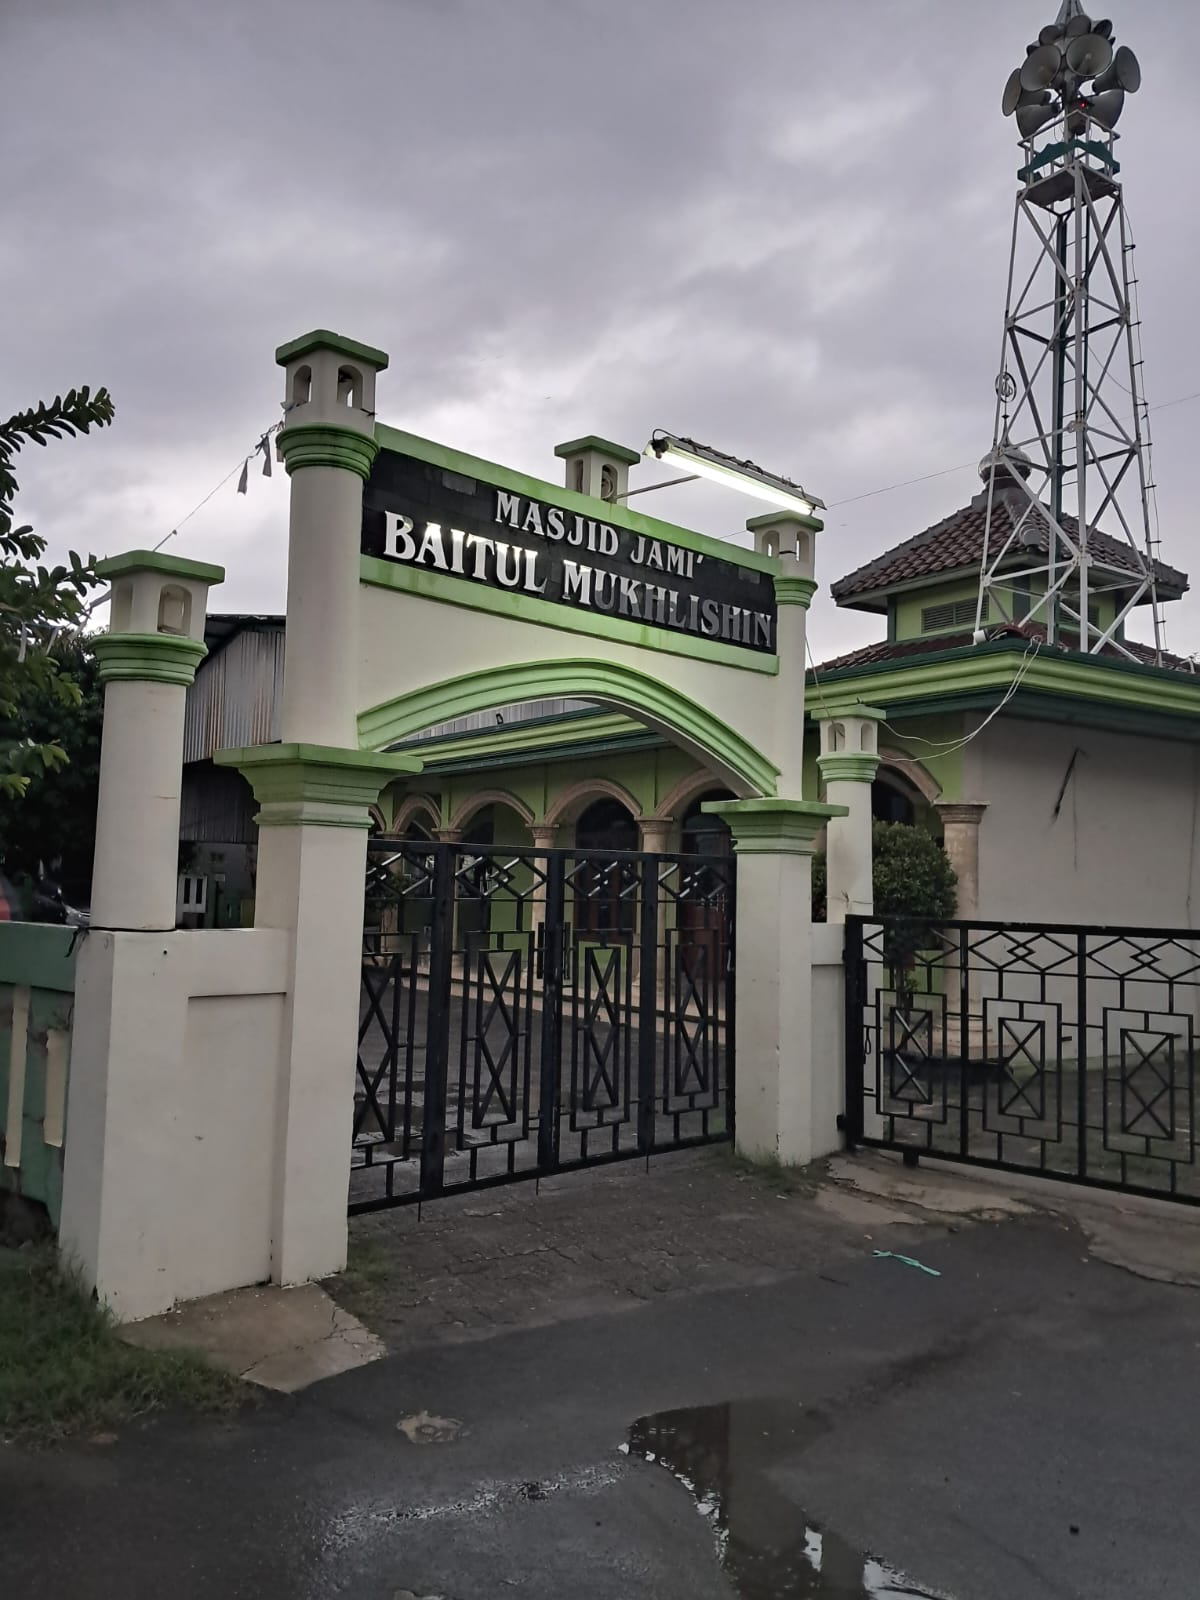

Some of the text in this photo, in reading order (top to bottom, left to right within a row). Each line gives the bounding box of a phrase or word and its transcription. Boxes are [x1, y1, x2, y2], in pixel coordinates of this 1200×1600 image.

[383, 510, 772, 648] BAITUL MUKHLISHIN
[495, 490, 703, 580] MASJID JAMI'
